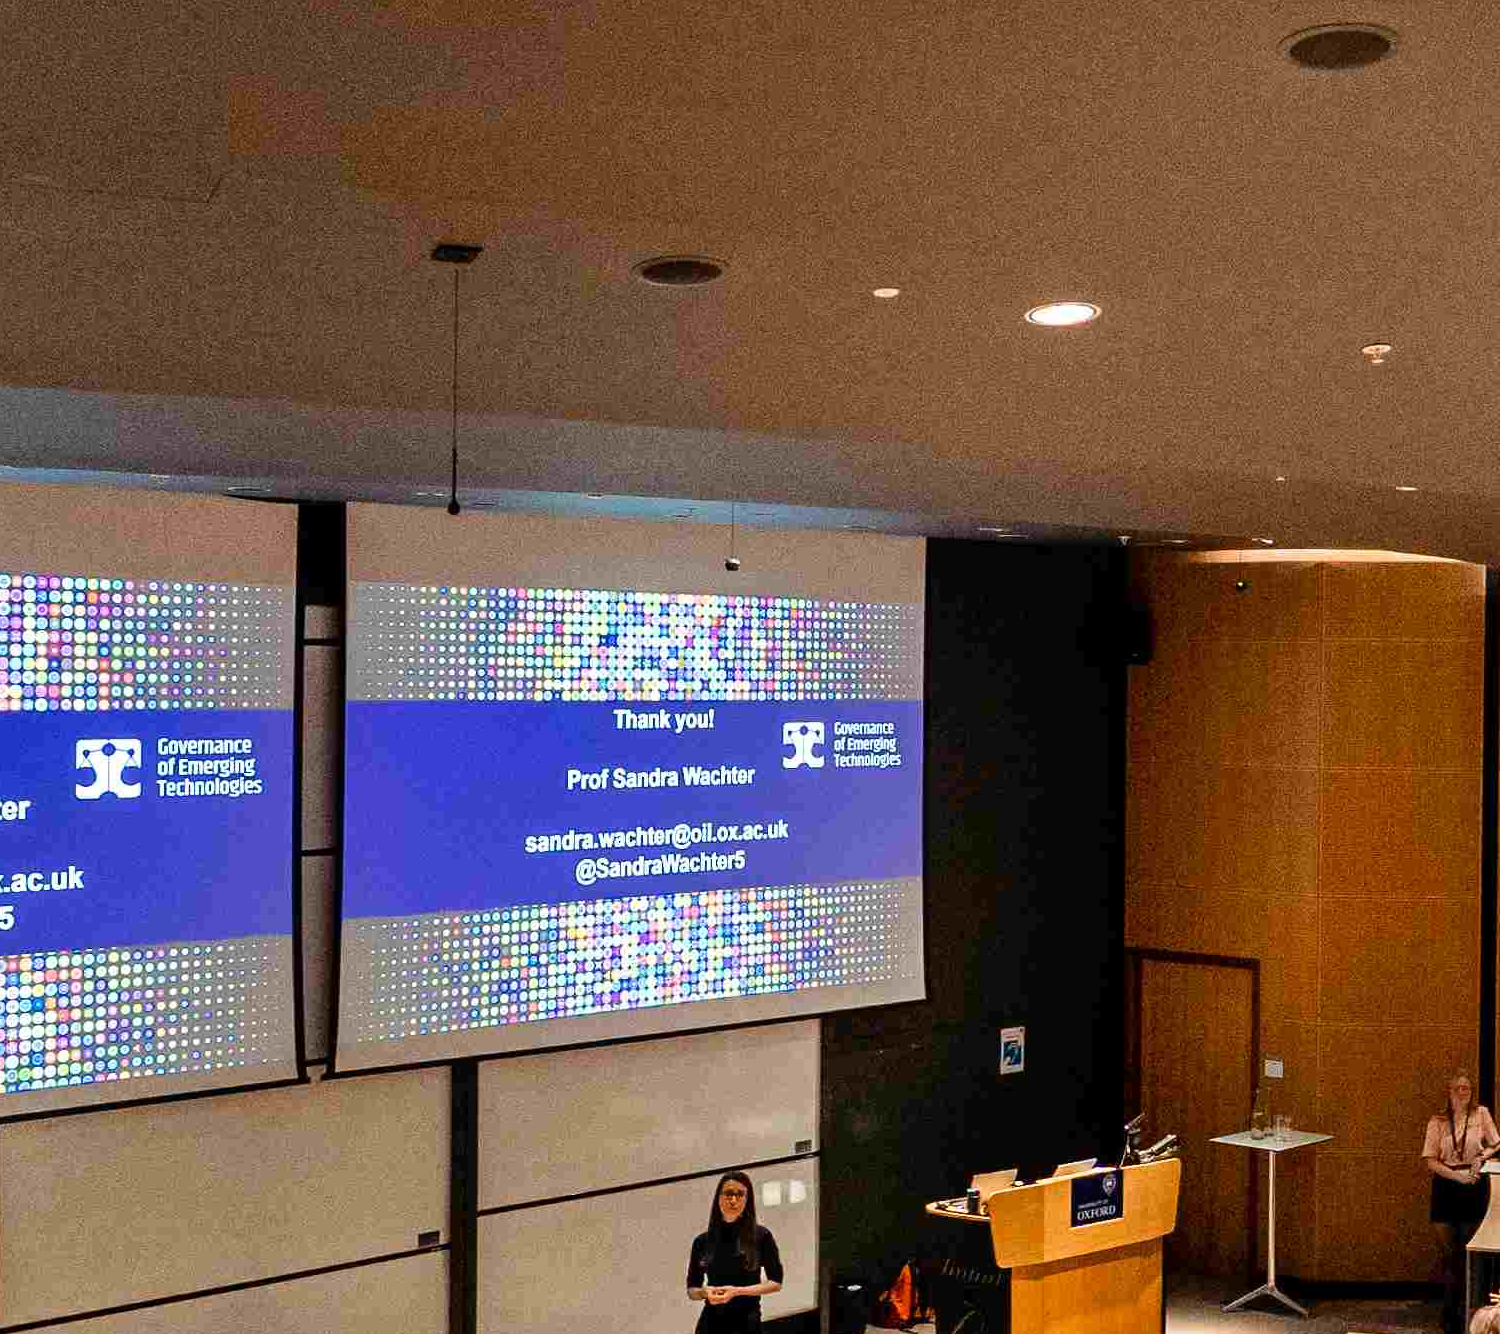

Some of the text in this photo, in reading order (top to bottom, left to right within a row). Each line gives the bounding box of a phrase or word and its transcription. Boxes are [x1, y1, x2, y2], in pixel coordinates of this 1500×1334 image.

[614, 709, 715, 734] Thank you!
[833, 721, 895, 736] Governance
[156, 737, 252, 756] Governance
[833, 736, 897, 754] of Emerging
[156, 757, 256, 777] of Emerging
[833, 751, 902, 769] Technologies
[156, 776, 262, 798] Technologies
[567, 765, 756, 790] Prof Sandra Wachter
[524, 819, 789, 854] sandra.wachter@oii.ox.ac.uk
[575, 850, 746, 885] @SandraWachter5
[1077, 1205, 1116, 1220] OXFORD
